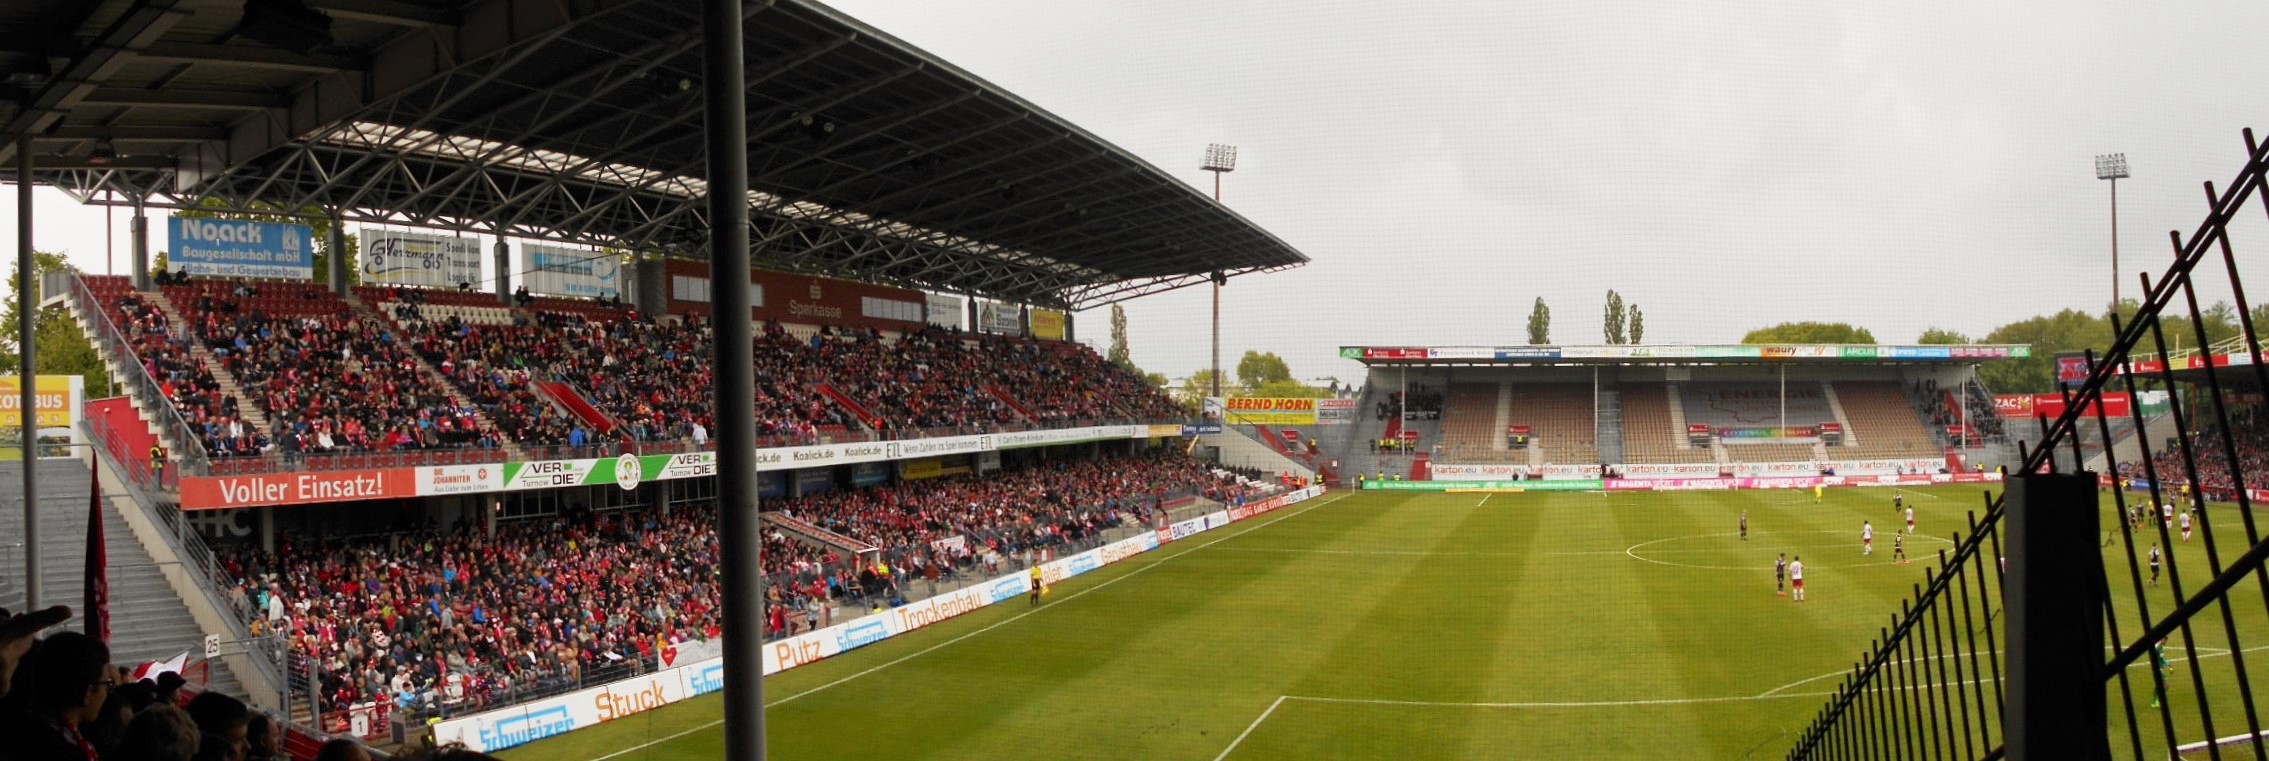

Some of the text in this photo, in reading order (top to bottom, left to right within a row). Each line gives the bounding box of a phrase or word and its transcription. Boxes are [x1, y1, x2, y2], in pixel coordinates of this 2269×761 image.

[182, 219, 261, 243] Noack
[183, 245, 300, 262] Baugesellschaft mbH
[217, 264, 234, 274] und
[789, 299, 842, 319] Sparkasse
[1766, 346, 1797, 356] waury
[0, 394, 63, 409] OTBUS
[1227, 398, 1312, 411] BERND HORN
[1995, 398, 2016, 408] ZAC
[845, 445, 882, 457] Koalick.de
[886, 442, 902, 458] ETL
[980, 436, 993, 450] ETL
[678, 454, 700, 465] VER
[756, 452, 781, 463] ck.de
[793, 449, 835, 461] Koalick.de
[531, 462, 562, 474] VER
[694, 464, 711, 475] DIE
[1434, 464, 1477, 474] karton.eu
[1626, 463, 1668, 473] karton.eu
[1768, 462, 1809, 471] karton.eu
[1859, 460, 1899, 470] karton.eu
[433, 475, 471, 484] JOHANNITER
[522, 480, 549, 488] Turnow
[552, 473, 574, 485] DIE
[219, 472, 383, 504] Voller Einsatz!
[1041, 564, 1062, 584] aler
[898, 590, 982, 632] Trockenbau
[207, 640, 218, 653] 25
[776, 640, 823, 671] Putz
[594, 680, 668, 724] Stuck
[479, 715, 575, 753] Schweizer
